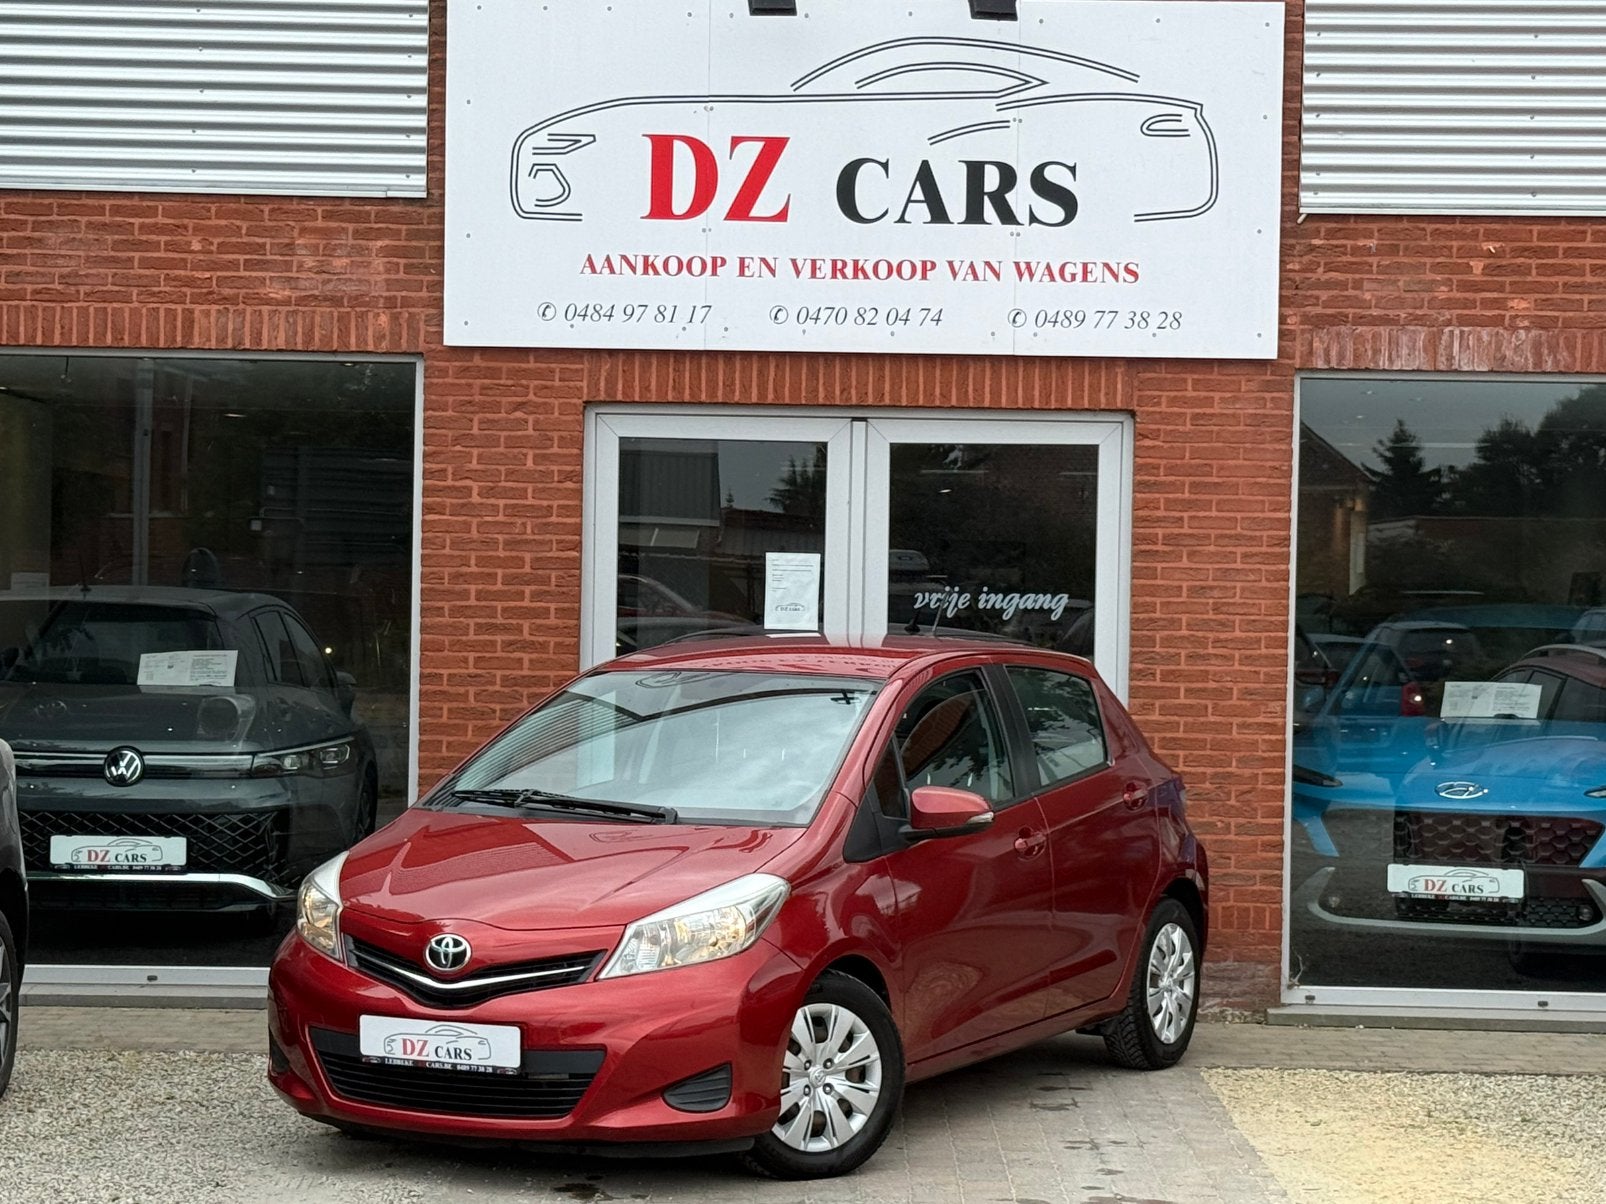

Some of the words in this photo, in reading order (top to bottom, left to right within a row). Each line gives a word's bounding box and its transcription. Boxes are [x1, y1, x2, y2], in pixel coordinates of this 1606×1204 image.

[641, 134, 791, 223] DZ
[836, 157, 1079, 228] CARS
[580, 253, 727, 278] AANKOOP
[737, 256, 779, 279] EN
[789, 257, 938, 281] VERKOOP
[946, 260, 1003, 282] VAN
[1012, 261, 1140, 284] WAGENS
[564, 303, 616, 323] 0484
[622, 304, 649, 324] 97
[654, 304, 678, 324] 81
[686, 304, 713, 325] 17
[796, 306, 848, 326] 0470
[853, 307, 879, 327] 82
[885, 307, 912, 327] 04
[918, 307, 944, 327] 74
[1034, 309, 1087, 329] 0489
[1094, 310, 1118, 330] 77
[1124, 311, 1151, 330] 38
[1156, 311, 1183, 331] 28
[913, 586, 971, 618] vrije
[978, 586, 1069, 621] ingang
[87, 849, 110, 862] DZ
[114, 853, 147, 863] CARS
[1424, 879, 1447, 892] DZ
[1451, 883, 1484, 894] CARS
[401, 1038, 430, 1057] DZ
[434, 1045, 472, 1061] CARS
